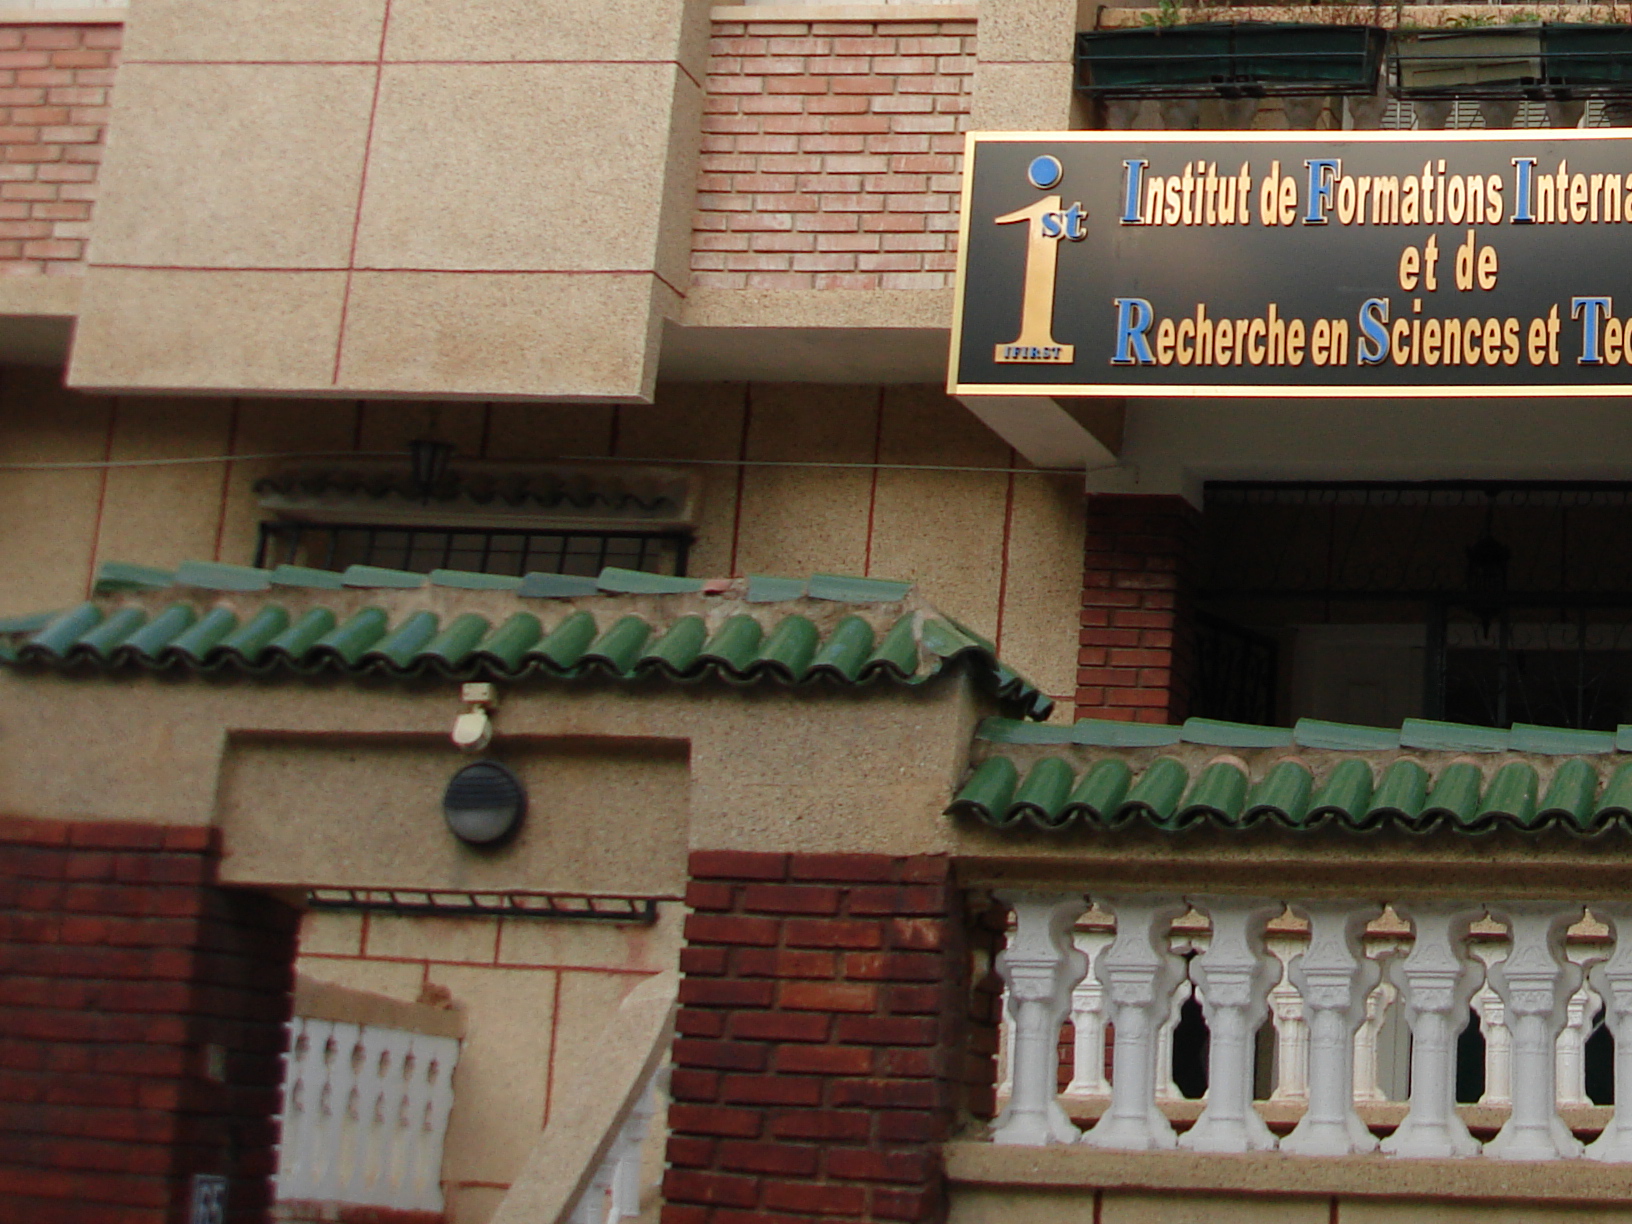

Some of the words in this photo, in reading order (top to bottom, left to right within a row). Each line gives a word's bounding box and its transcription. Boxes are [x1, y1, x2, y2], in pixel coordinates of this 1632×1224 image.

[1119, 158, 1251, 226] Institut
[1260, 160, 1298, 226] de
[1302, 157, 1503, 226] Formations
[1399, 233, 1439, 291] et
[1455, 229, 1498, 291] de
[1003, 346, 1062, 360] IFIRST
[1110, 297, 1305, 366] Recherche
[1311, 318, 1349, 366] en
[1357, 297, 1521, 366] Sciences
[1527, 303, 1561, 365] et
